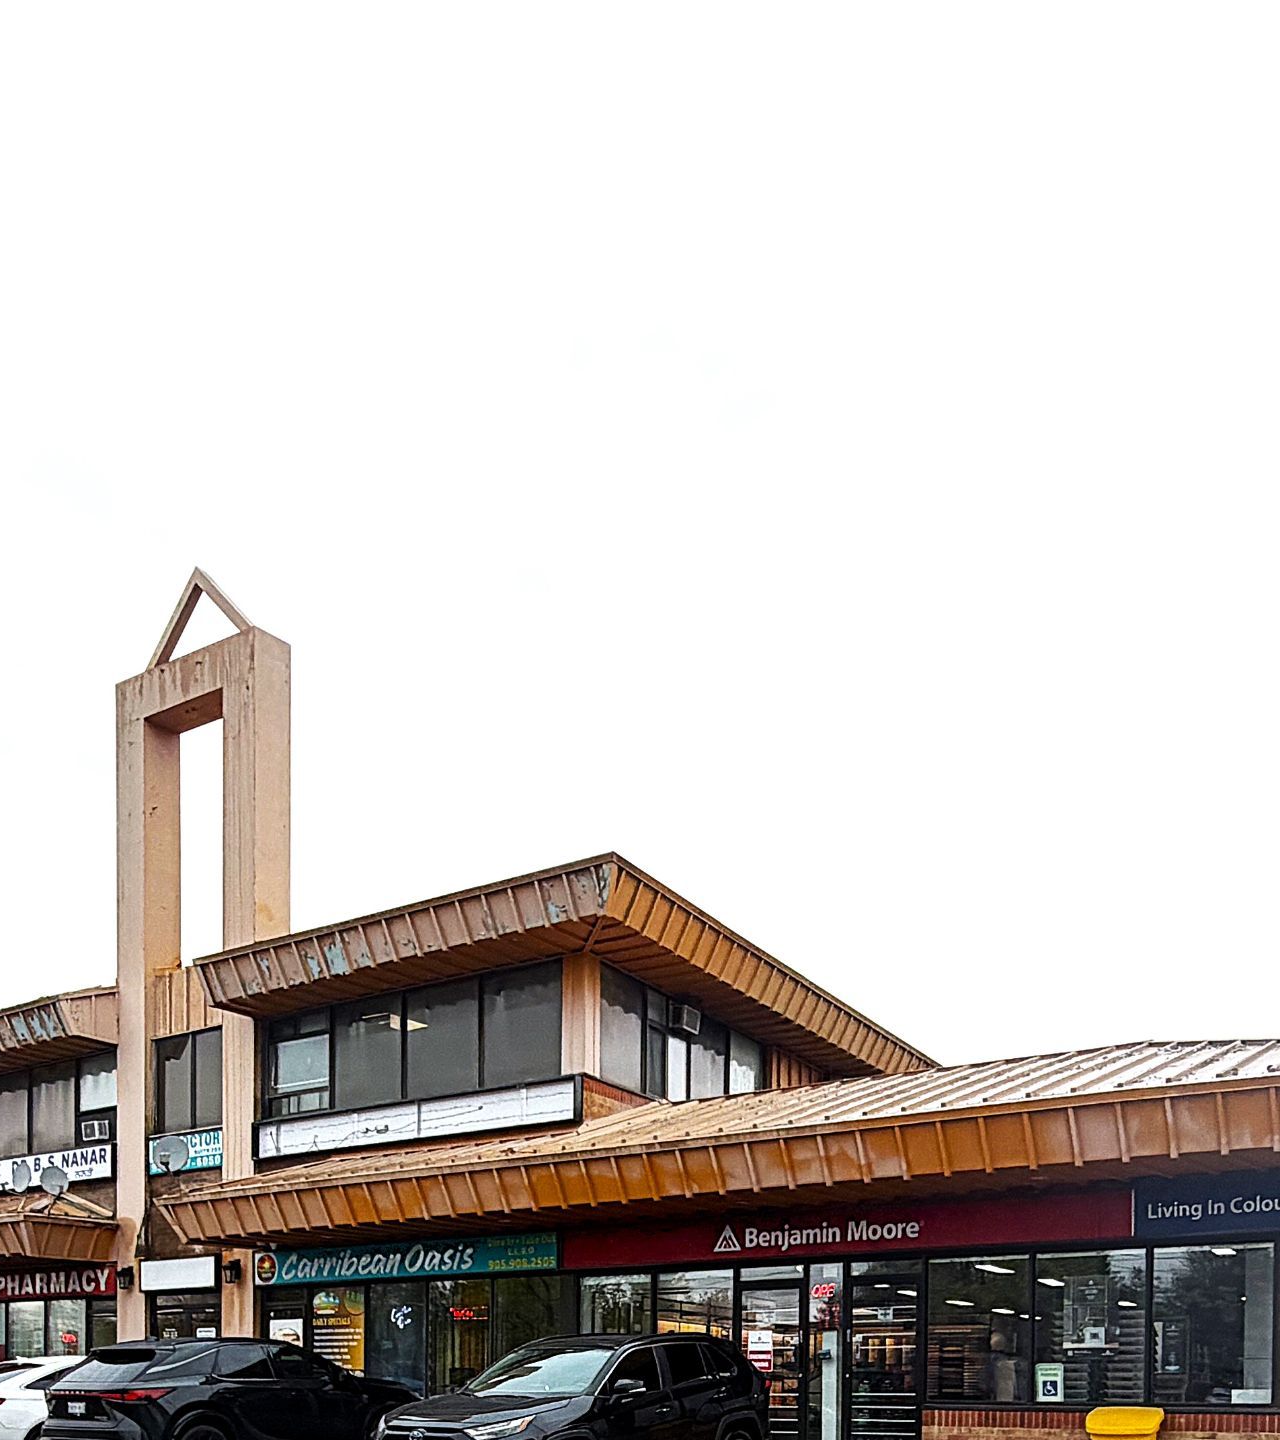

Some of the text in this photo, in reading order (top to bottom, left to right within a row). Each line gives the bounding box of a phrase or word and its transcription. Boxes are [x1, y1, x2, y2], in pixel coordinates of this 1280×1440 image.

[61, 1148, 107, 1169] NANAR
[1147, 1202, 1203, 1221] Living
[1208, 1199, 1225, 1215] In
[745, 1219, 920, 1251] Benjamin Moore
[281, 1243, 473, 1280] Carribean Oasis
